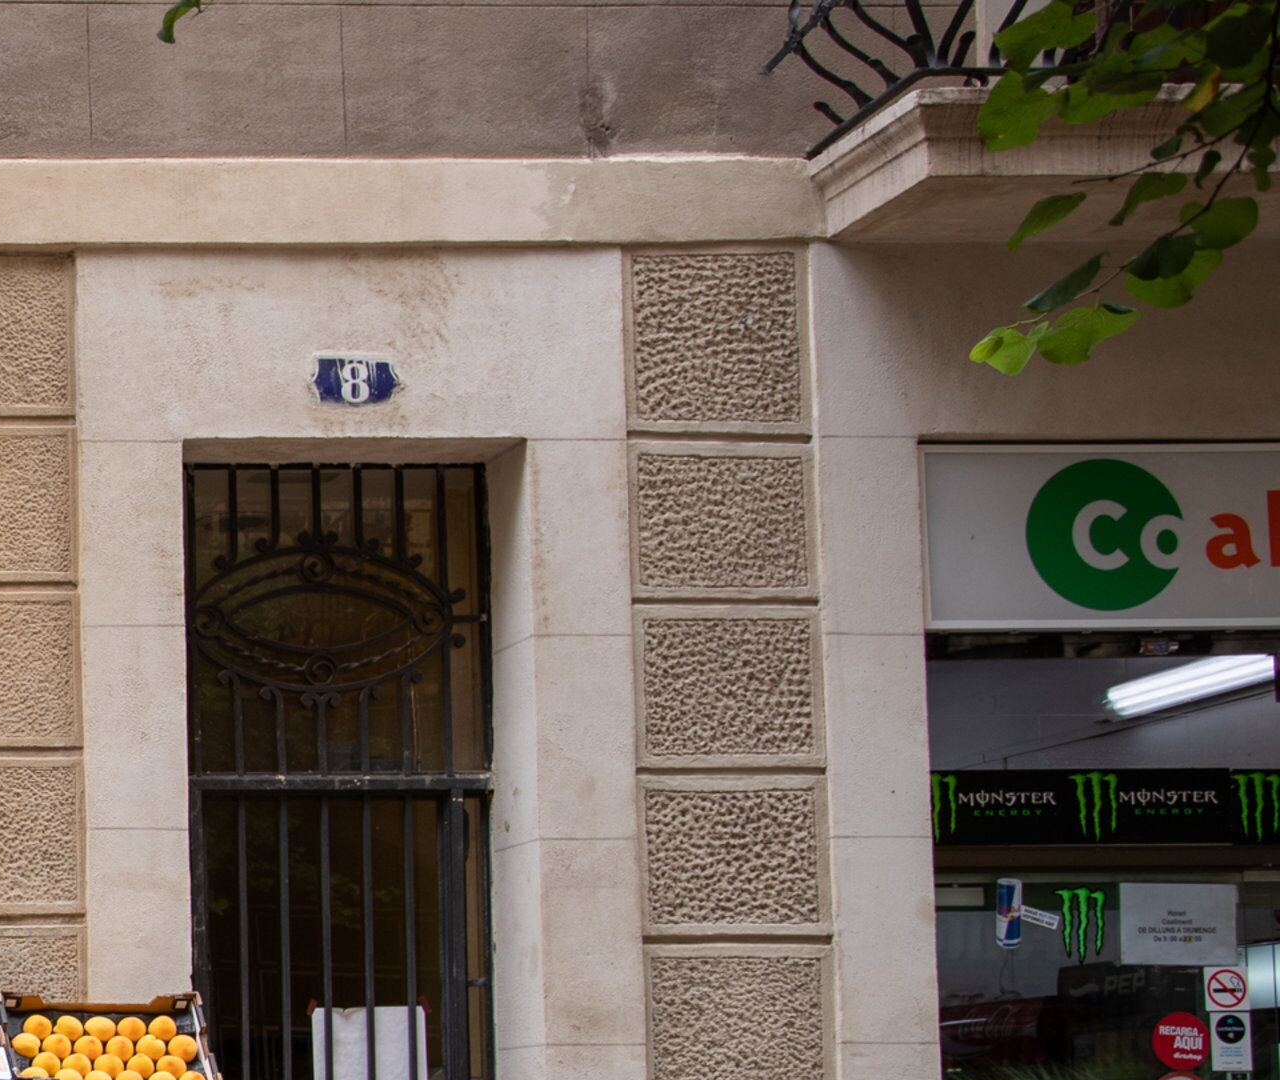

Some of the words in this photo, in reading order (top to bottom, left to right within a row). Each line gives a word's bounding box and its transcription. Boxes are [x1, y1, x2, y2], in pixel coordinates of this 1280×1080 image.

[341, 360, 370, 404] 8
[958, 789, 1057, 807] MONSTER
[1119, 788, 1219, 806] MONSTER
[974, 809, 1043, 817] ENERGY
[1134, 808, 1204, 816] ENERGY
[1159, 1025, 1198, 1037] RECARGA
[1173, 1033, 1204, 1051] AQUÍ
